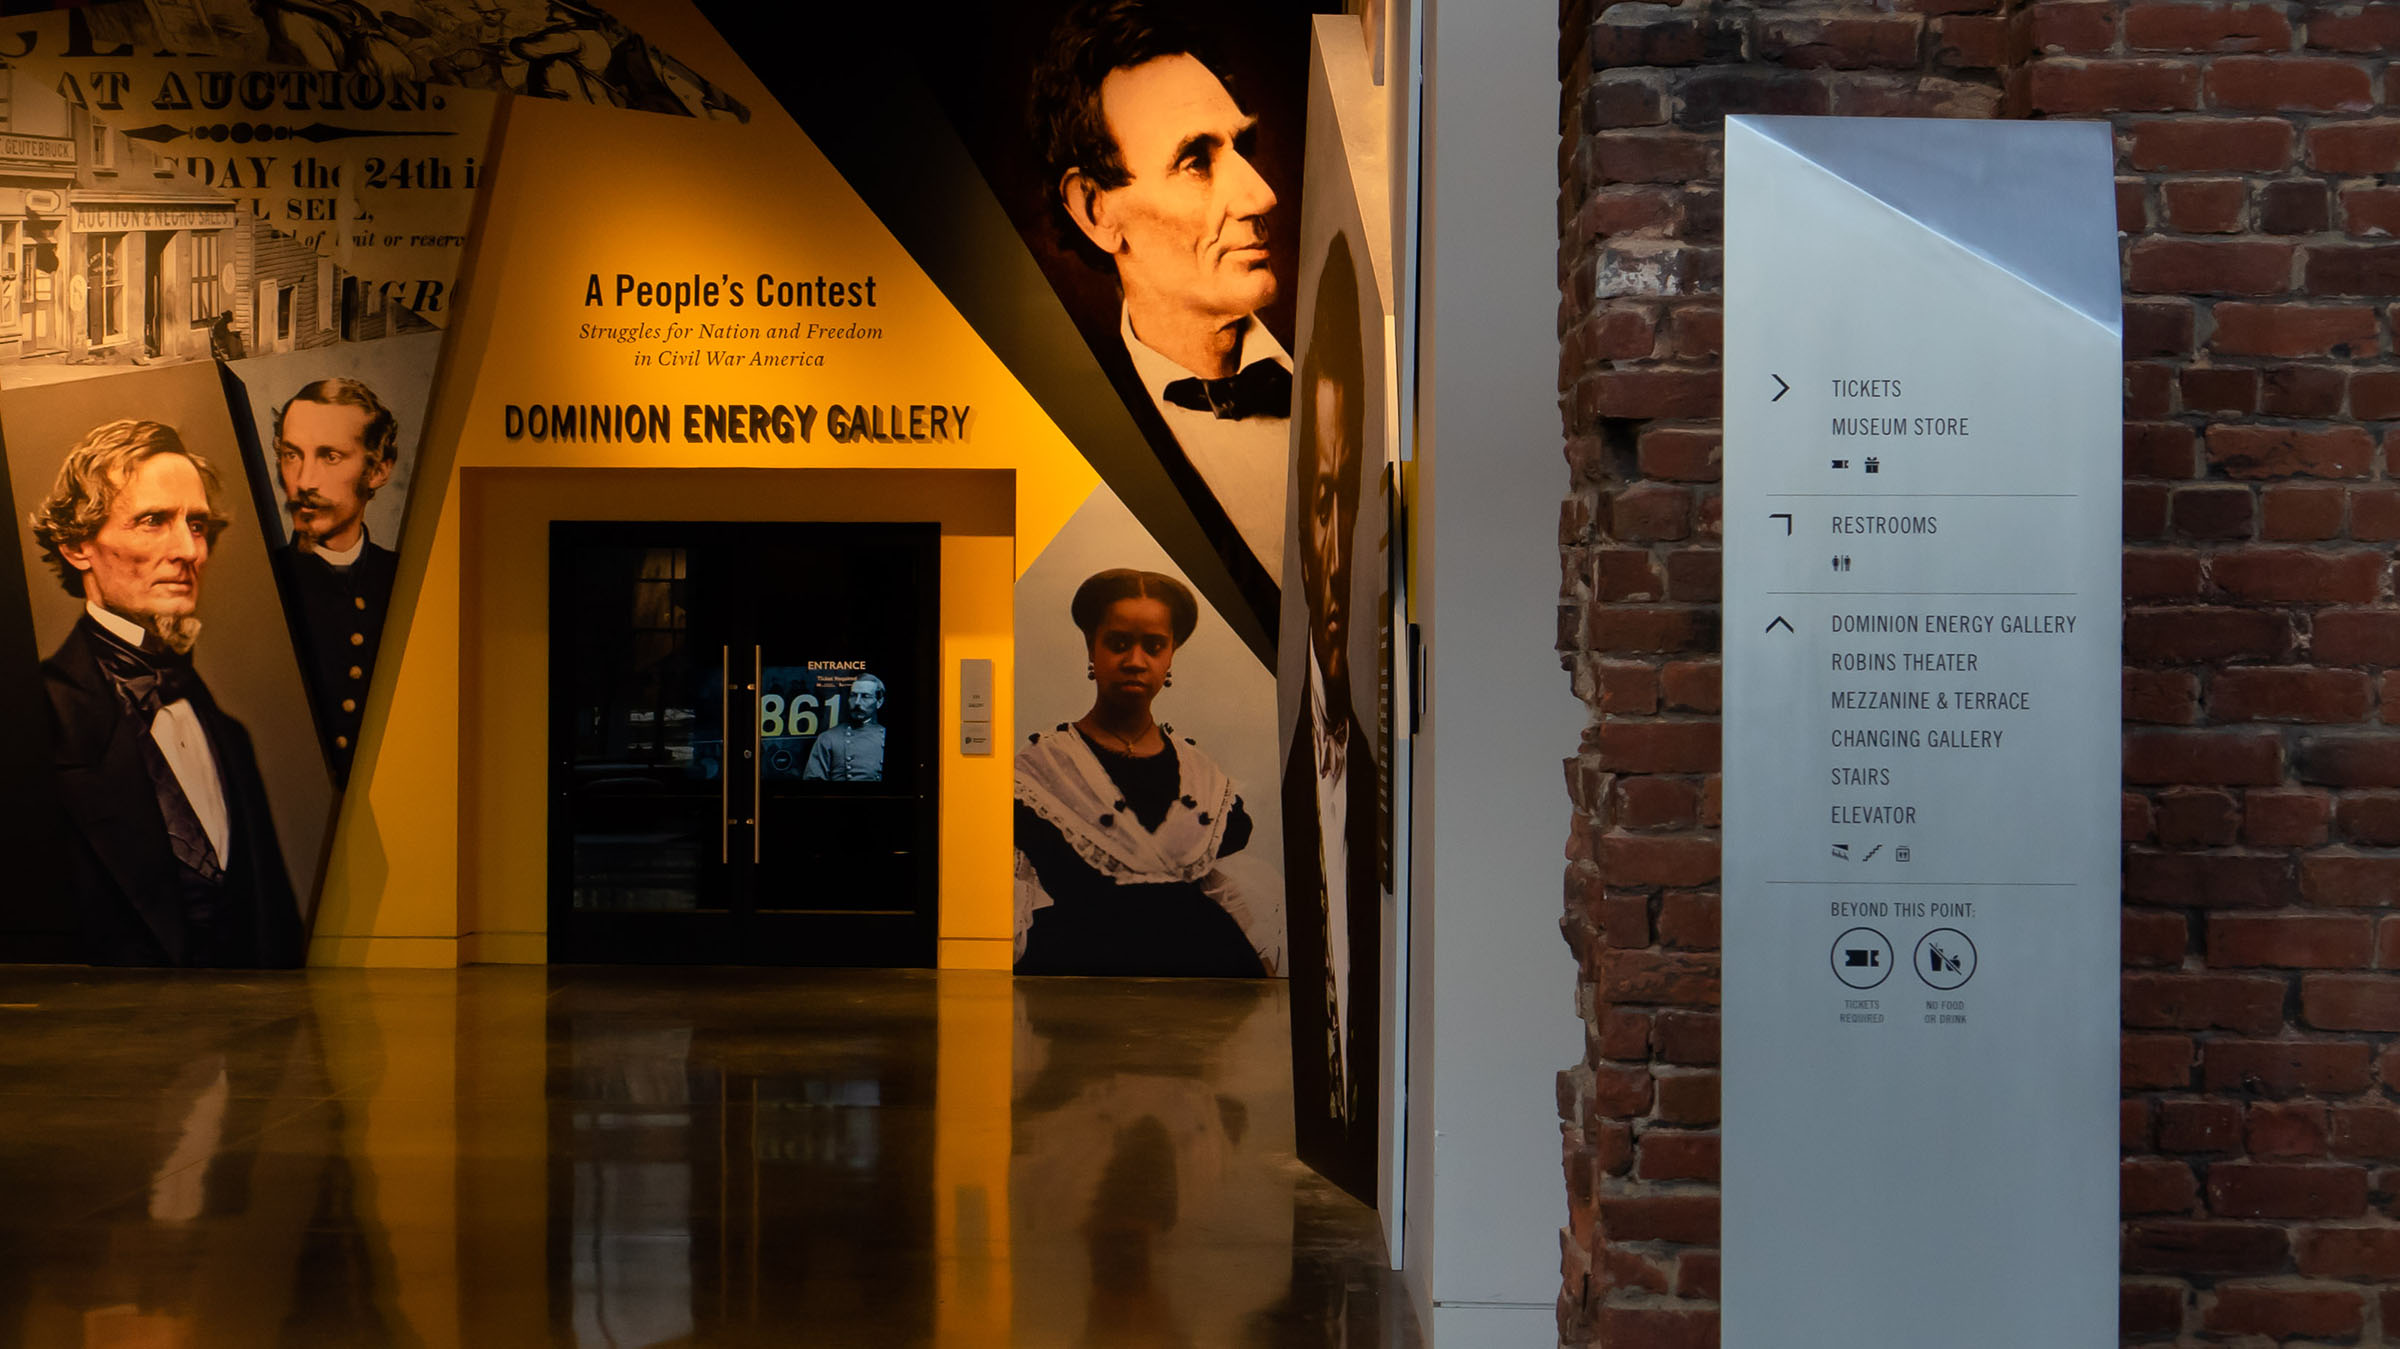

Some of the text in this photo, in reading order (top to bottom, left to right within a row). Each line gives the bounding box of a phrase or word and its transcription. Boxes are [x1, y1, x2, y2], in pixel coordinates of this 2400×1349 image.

[151, 71, 446, 110] AUCTION.
[163, 157, 277, 190] DAY
[364, 157, 452, 190] 24th
[77, 207, 140, 229] AUCTION
[143, 208, 153, 226] &
[383, 235, 403, 247] or
[584, 273, 604, 307] A
[756, 273, 877, 308] Contest
[579, 321, 883, 343] Struggles for Nation and Freedom
[634, 350, 825, 367] in Civil War America
[1831, 379, 1902, 398] TICKETS
[504, 404, 971, 441] DOMINION ENERGY GALLERY
[1831, 417, 1970, 436] MUSEUM STORE
[1831, 516, 1938, 535] RESTROOMS
[1831, 615, 2078, 633] DOMINION ENERGY GALLERY
[807, 661, 867, 670] ENTRANCE
[1831, 653, 1978, 671] ROBINS THEATER
[1831, 692, 2031, 710] MEZZANINE & TERRACE
[1831, 729, 2004, 748] CHANGING GALLERY
[1831, 767, 1890, 786] STAIRS
[1831, 806, 1917, 824] ELEVATOR
[1830, 902, 1976, 918] BEYOND THIS POINT:
[1844, 999, 1880, 1010] TICKETS
[1925, 1000, 1965, 1010] NO FOOD
[1839, 1013, 1885, 1024] REQUIRED
[1924, 1014, 1967, 1024] OR DRINK
